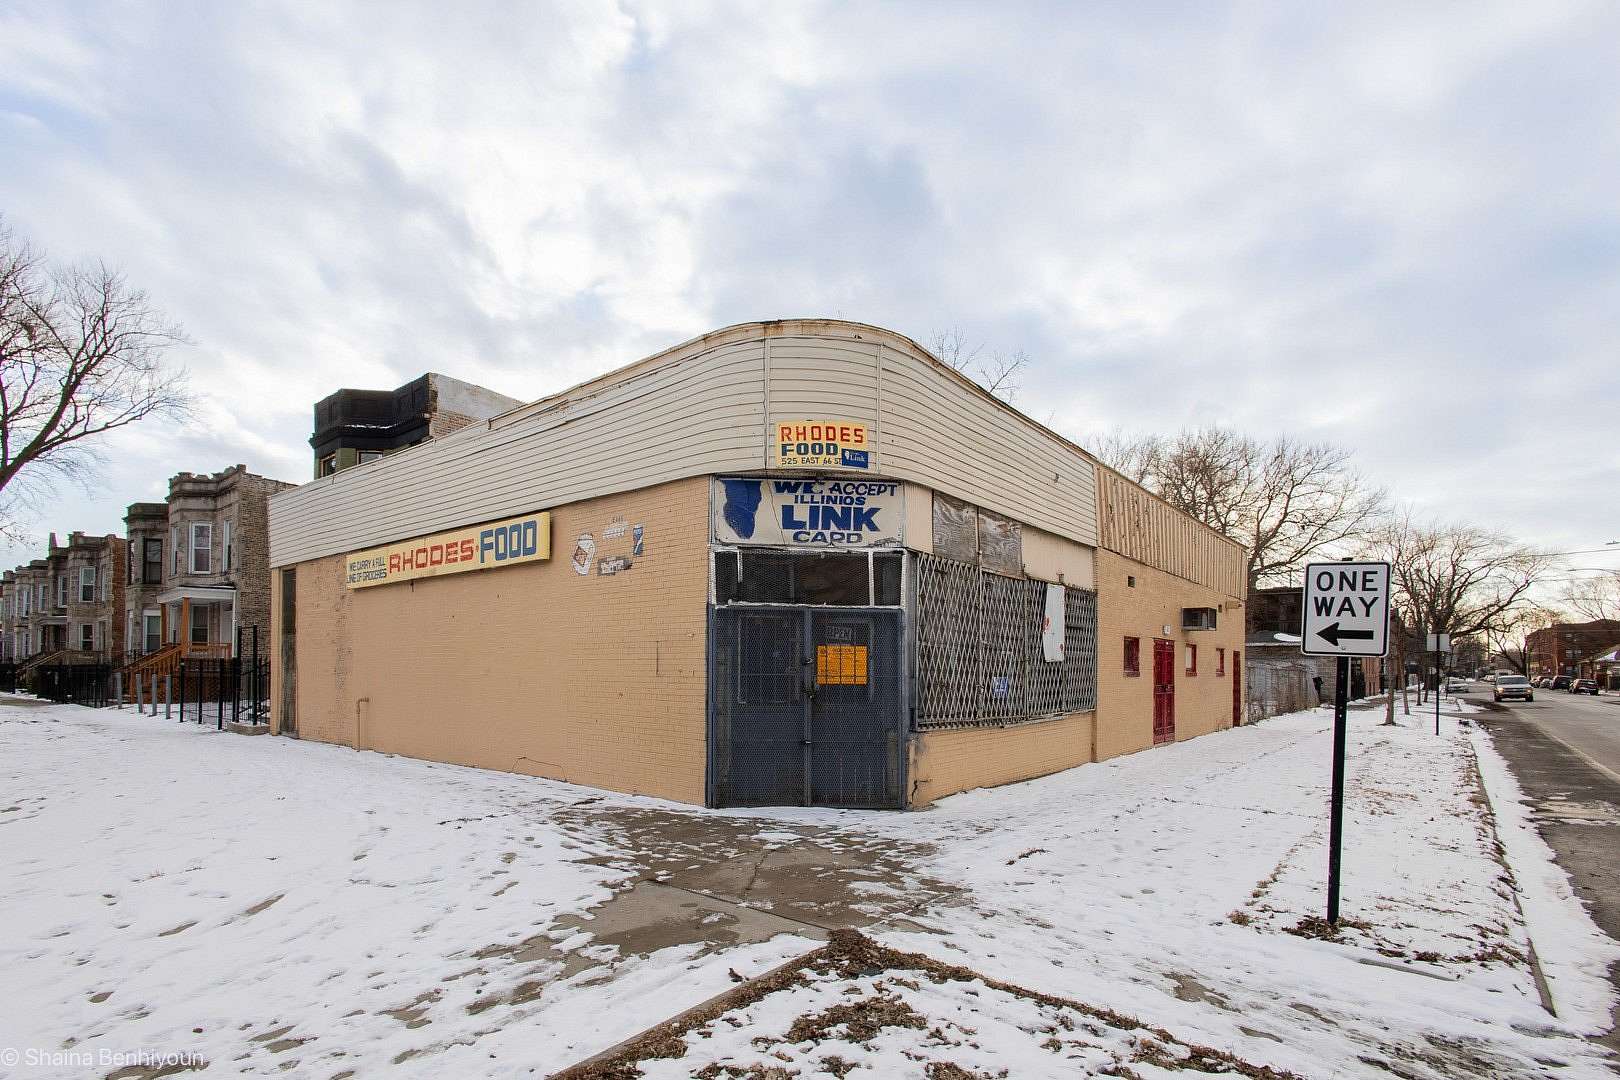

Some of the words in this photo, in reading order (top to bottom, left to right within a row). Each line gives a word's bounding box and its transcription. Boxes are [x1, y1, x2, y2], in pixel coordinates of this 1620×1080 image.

[781, 426, 864, 443] RHODES
[781, 443, 839, 456] FOOD
[781, 457, 798, 465] 525
[823, 457, 833, 465] 66
[829, 482, 897, 496] ACCEPT
[794, 495, 866, 505] ILLINIOS
[781, 505, 882, 531] LINK
[793, 531, 863, 544] CARD
[389, 538, 475, 574] RHODES
[480, 520, 538, 564] FOOD
[1316, 571, 1378, 591] ONE
[1314, 597, 1379, 617] WAY
